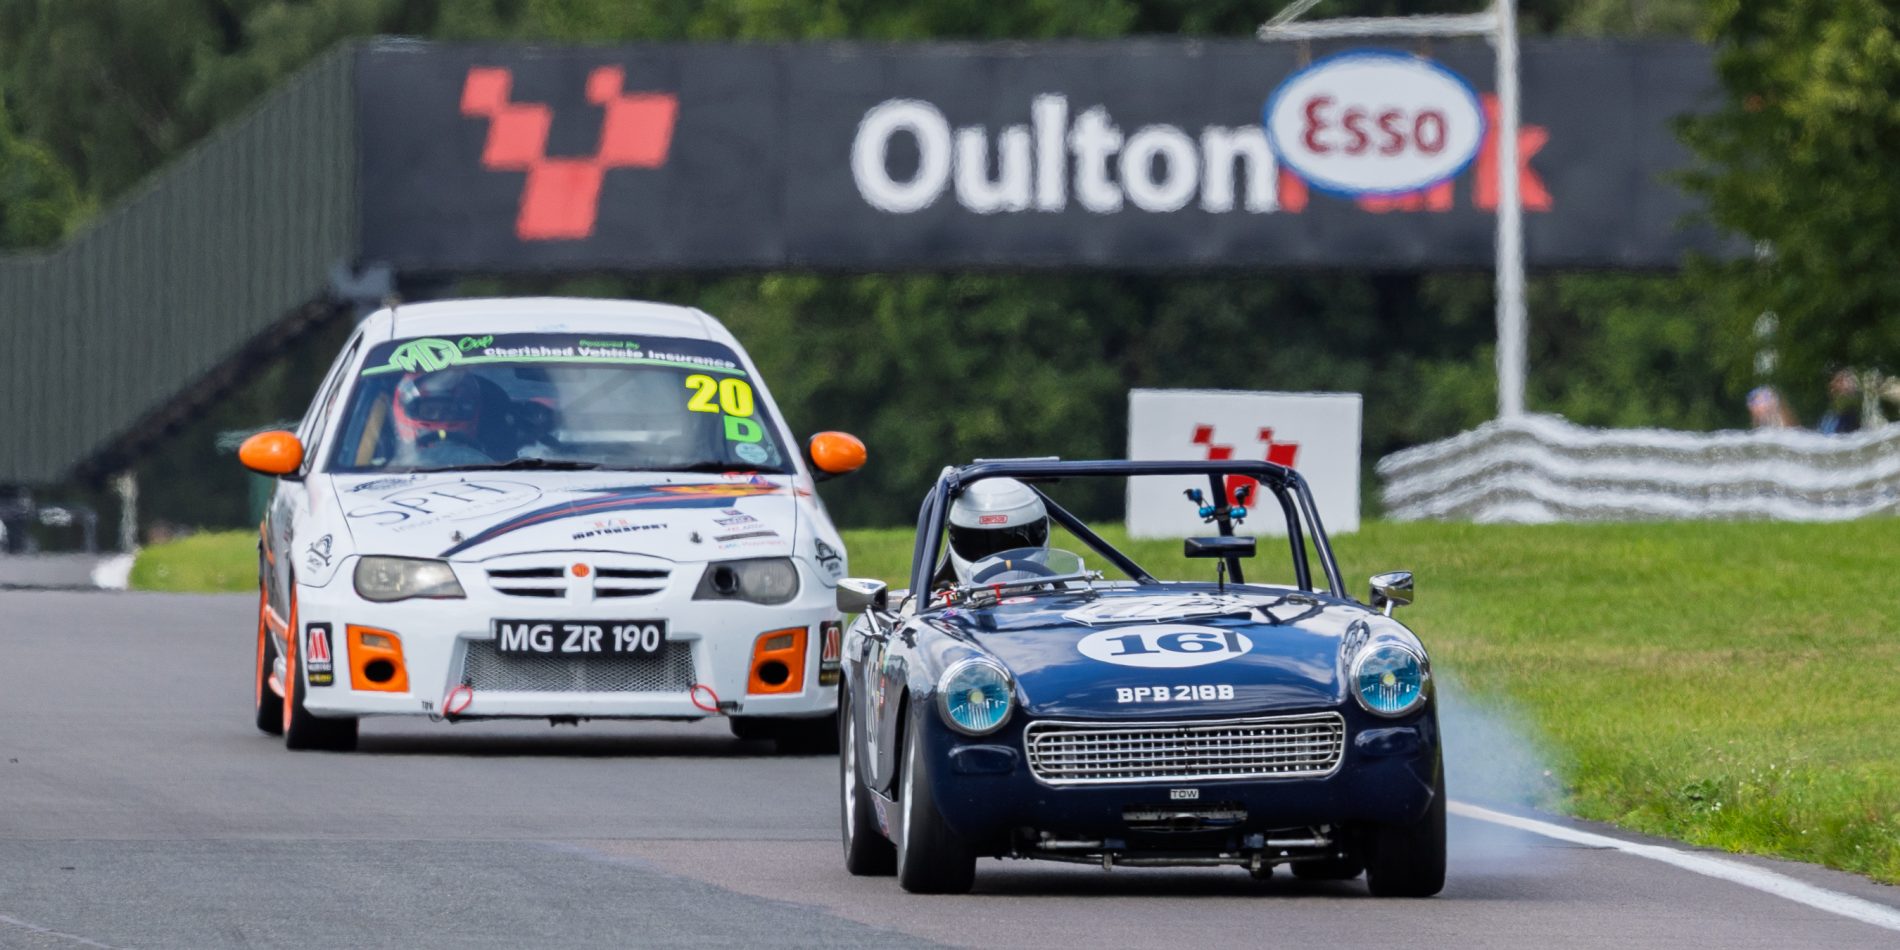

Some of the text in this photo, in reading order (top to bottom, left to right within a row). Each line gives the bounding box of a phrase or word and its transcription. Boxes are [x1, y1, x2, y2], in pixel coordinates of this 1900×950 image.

[1301, 95, 1448, 157] Esso
[852, 93, 1280, 214] Oulton
[390, 338, 462, 373] MG
[483, 346, 736, 369] Cherished Vehicle Insurance
[685, 374, 755, 417] 20
[723, 415, 763, 443] D
[500, 623, 661, 653] MG ZR 190
[1115, 684, 1235, 703] BPB 218B
[1170, 789, 1198, 799] TOW
